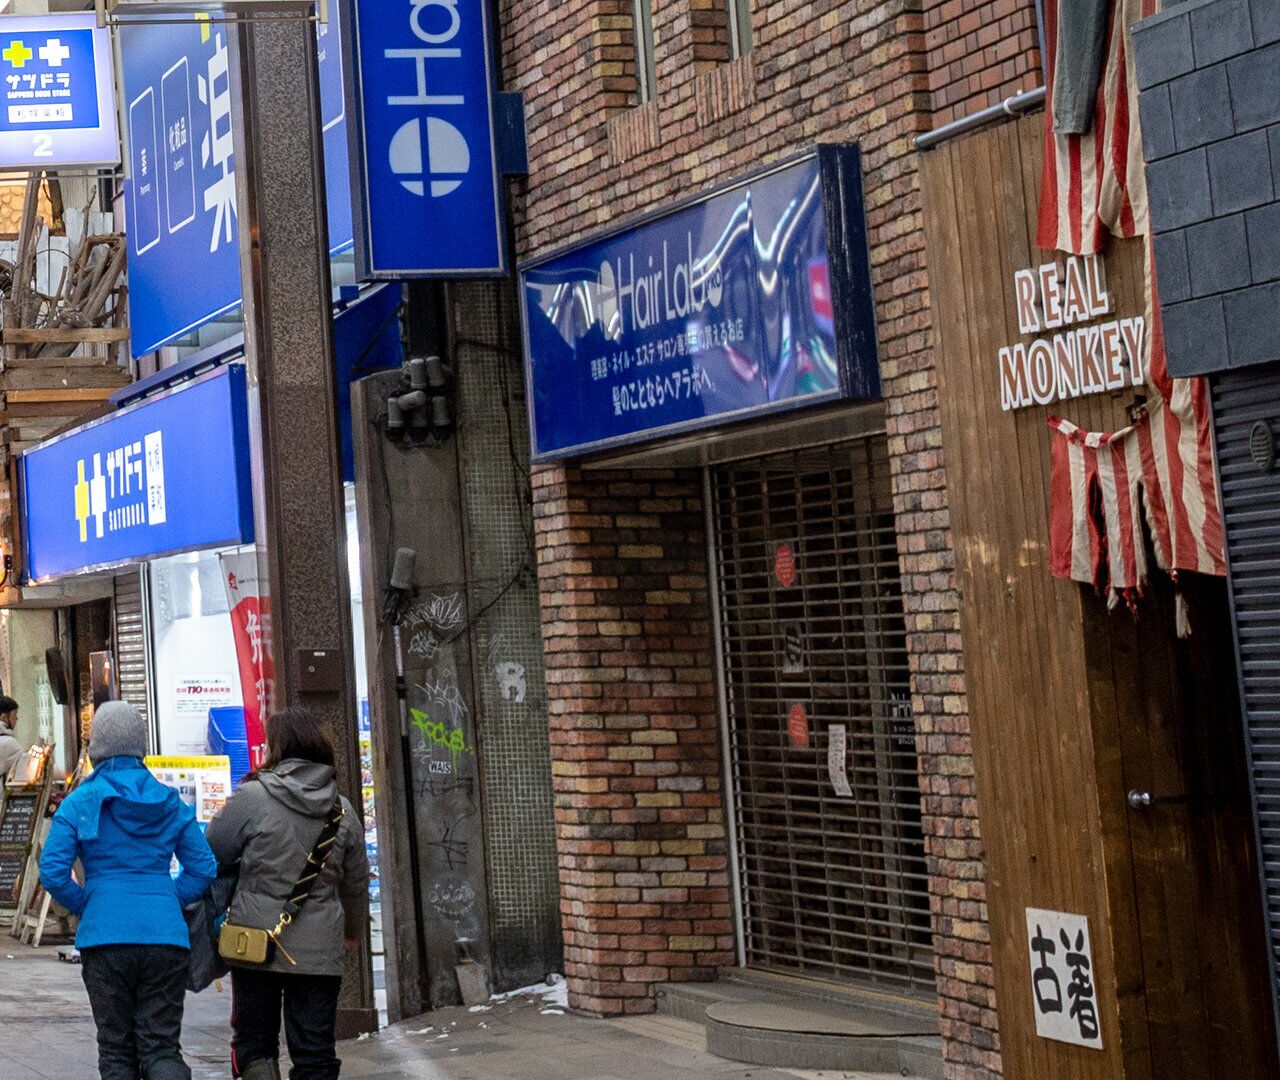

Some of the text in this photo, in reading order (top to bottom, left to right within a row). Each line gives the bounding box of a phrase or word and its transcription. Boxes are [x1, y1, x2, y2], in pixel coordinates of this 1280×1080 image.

[6, 73, 70, 89] サツドラ
[33, 134, 53, 156] 2
[1015, 254, 1109, 334] REAL
[998, 316, 1144, 411] MONKEY
